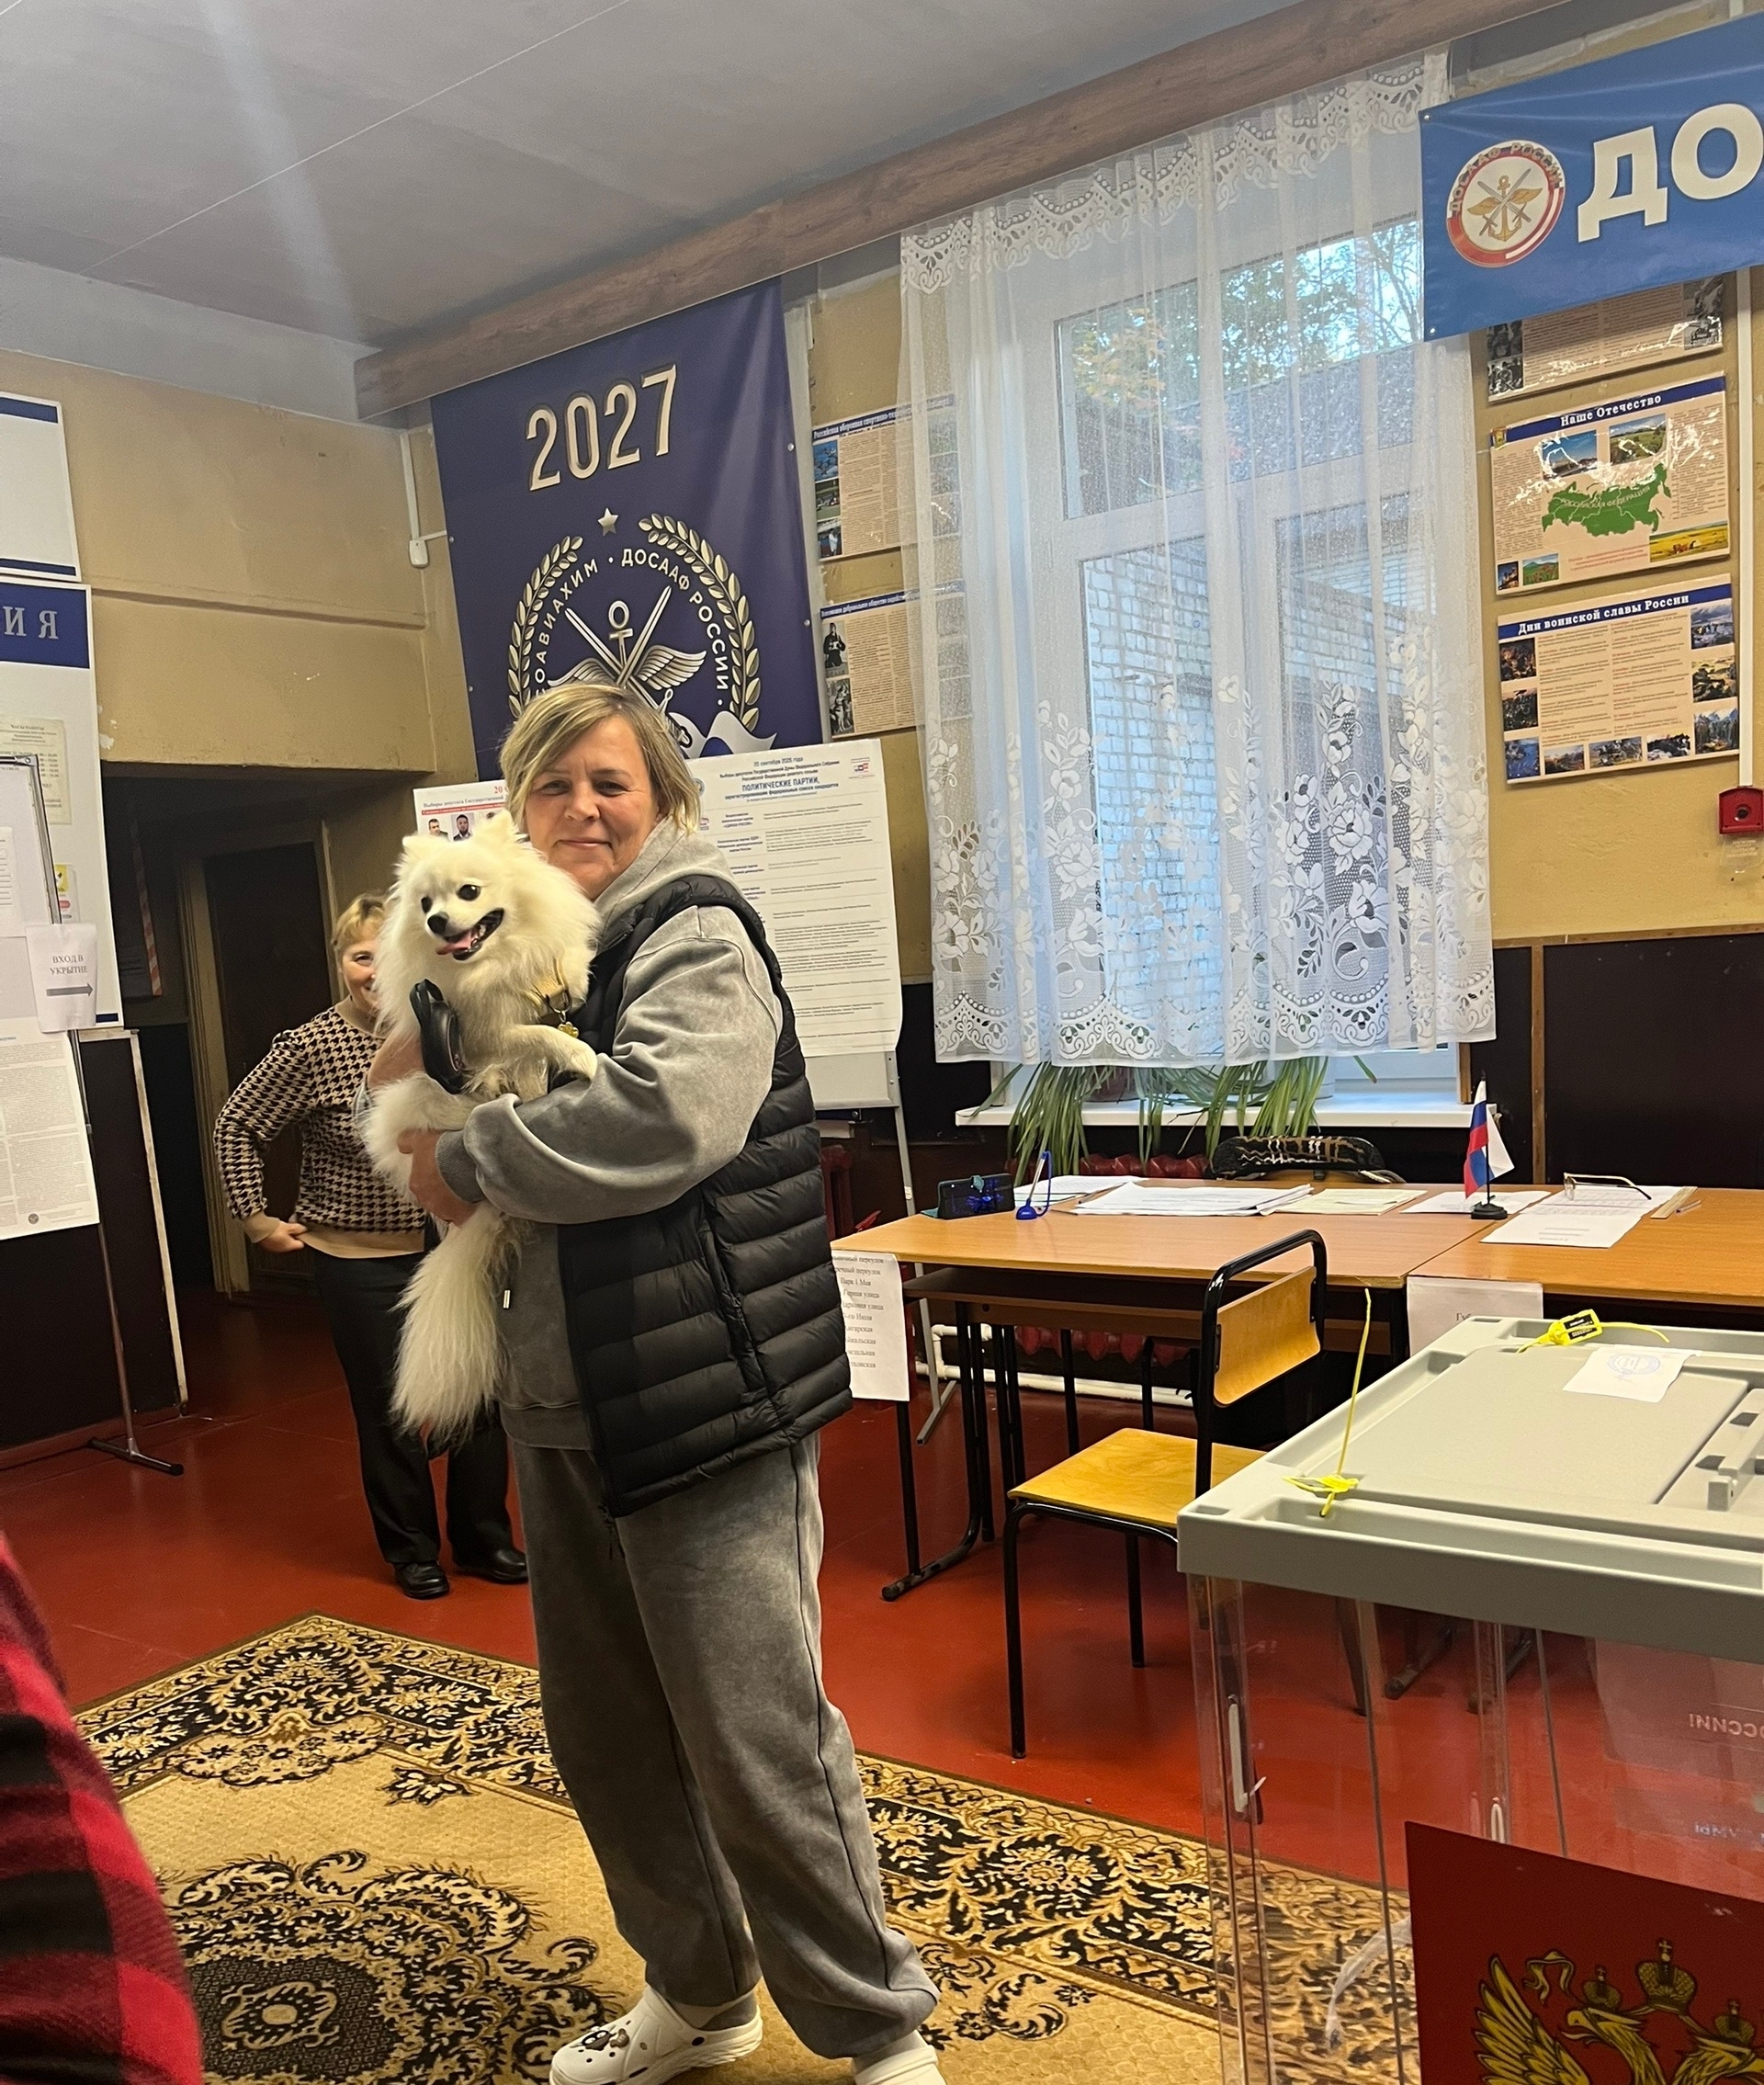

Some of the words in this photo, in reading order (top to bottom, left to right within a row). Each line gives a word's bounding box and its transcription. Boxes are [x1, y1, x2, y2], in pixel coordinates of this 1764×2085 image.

[1578, 103, 1764, 243] ДО
[1561, 411, 1593, 426] Наше
[1596, 394, 1662, 417] Отечество
[526, 365, 677, 492] 2027
[534, 559, 598, 696] ОАВИАХИМ
[621, 549, 690, 591] ДОСААФ
[689, 591, 729, 689] РОССИИ
[1518, 622, 1541, 635] Дни
[1544, 609, 1600, 629] воинской
[1604, 602, 1642, 618] славы
[1645, 594, 1690, 611] России
[742, 779, 792, 792] ПОЛИТИЧЕСКИЕ
[50, 966, 88, 975] УКРЫТИЕ
[52, 955, 77, 964] ВХОД
[78, 954, 84, 962] В
